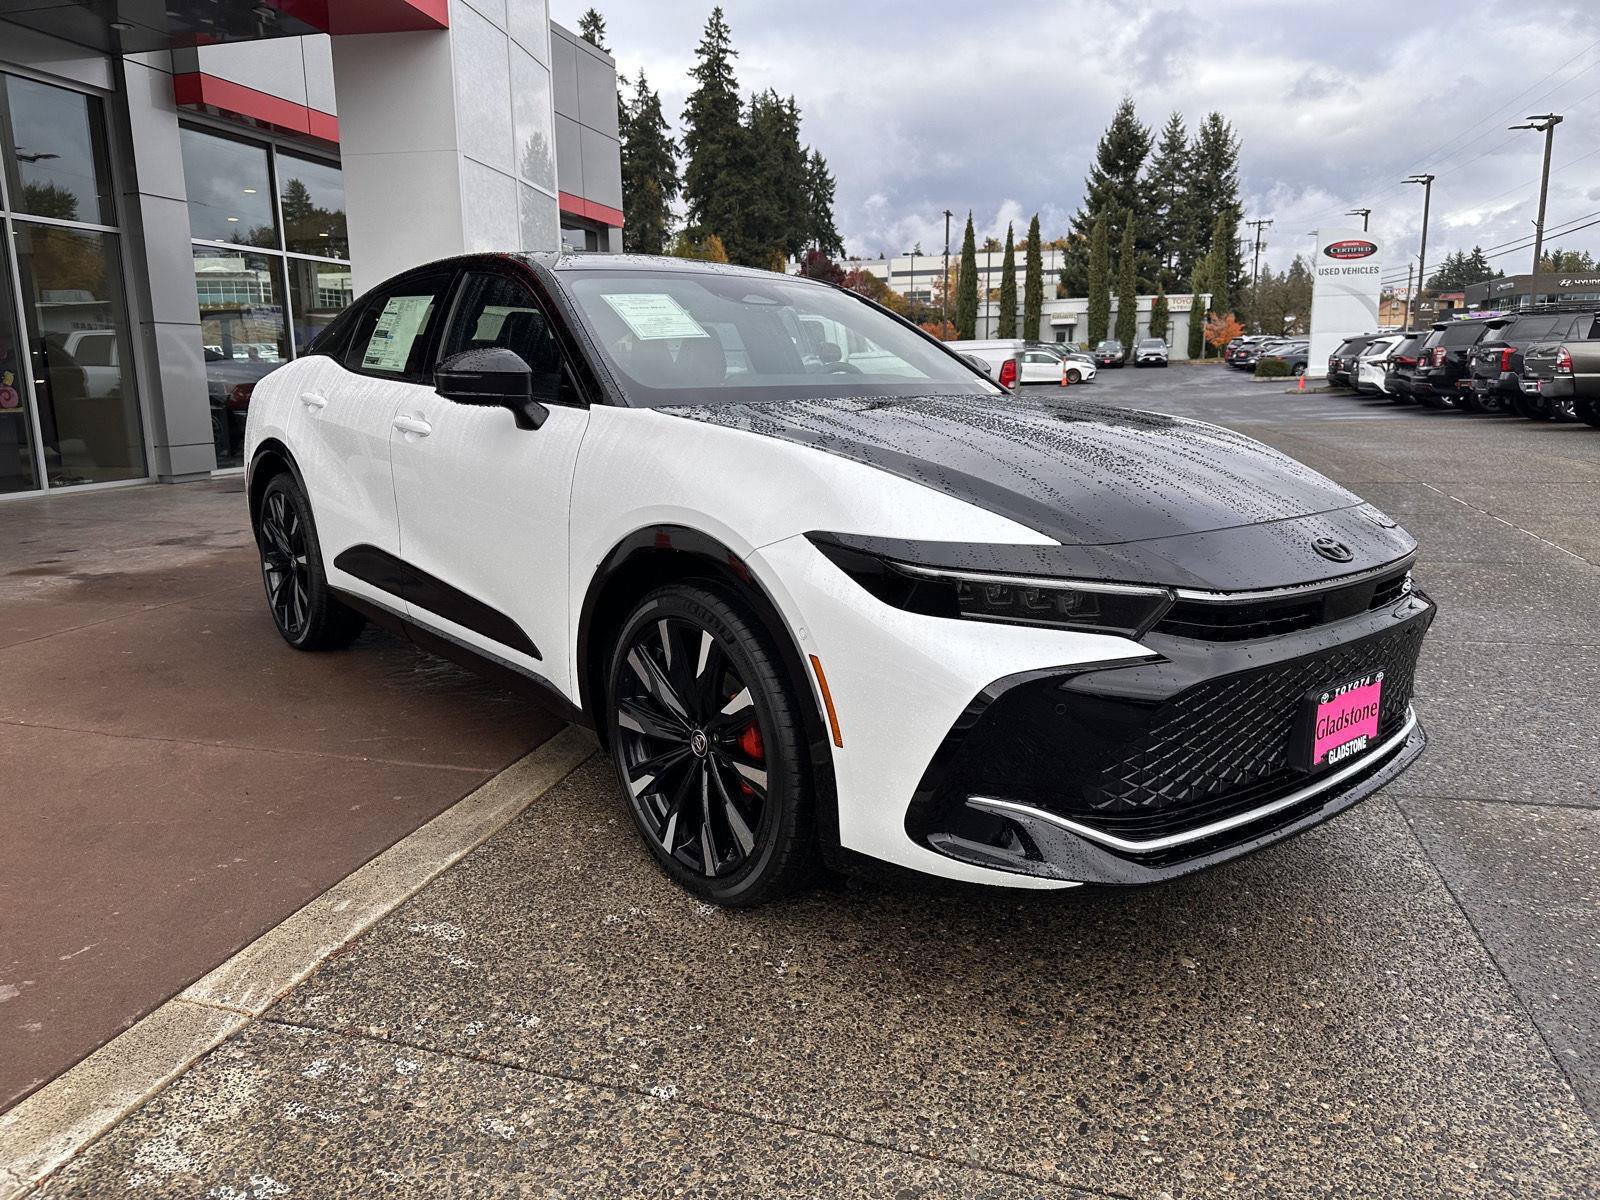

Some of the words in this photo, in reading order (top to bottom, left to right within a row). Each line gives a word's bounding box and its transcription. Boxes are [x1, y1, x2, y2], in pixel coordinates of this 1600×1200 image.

[1330, 246, 1371, 254] CERTIFIED
[1318, 267, 1340, 276] USED
[1341, 266, 1380, 275] VEHICLES
[1335, 676, 1370, 697] TOYOTA
[1316, 702, 1378, 740] Gladstone
[1328, 735, 1367, 765] GLADSTONE
